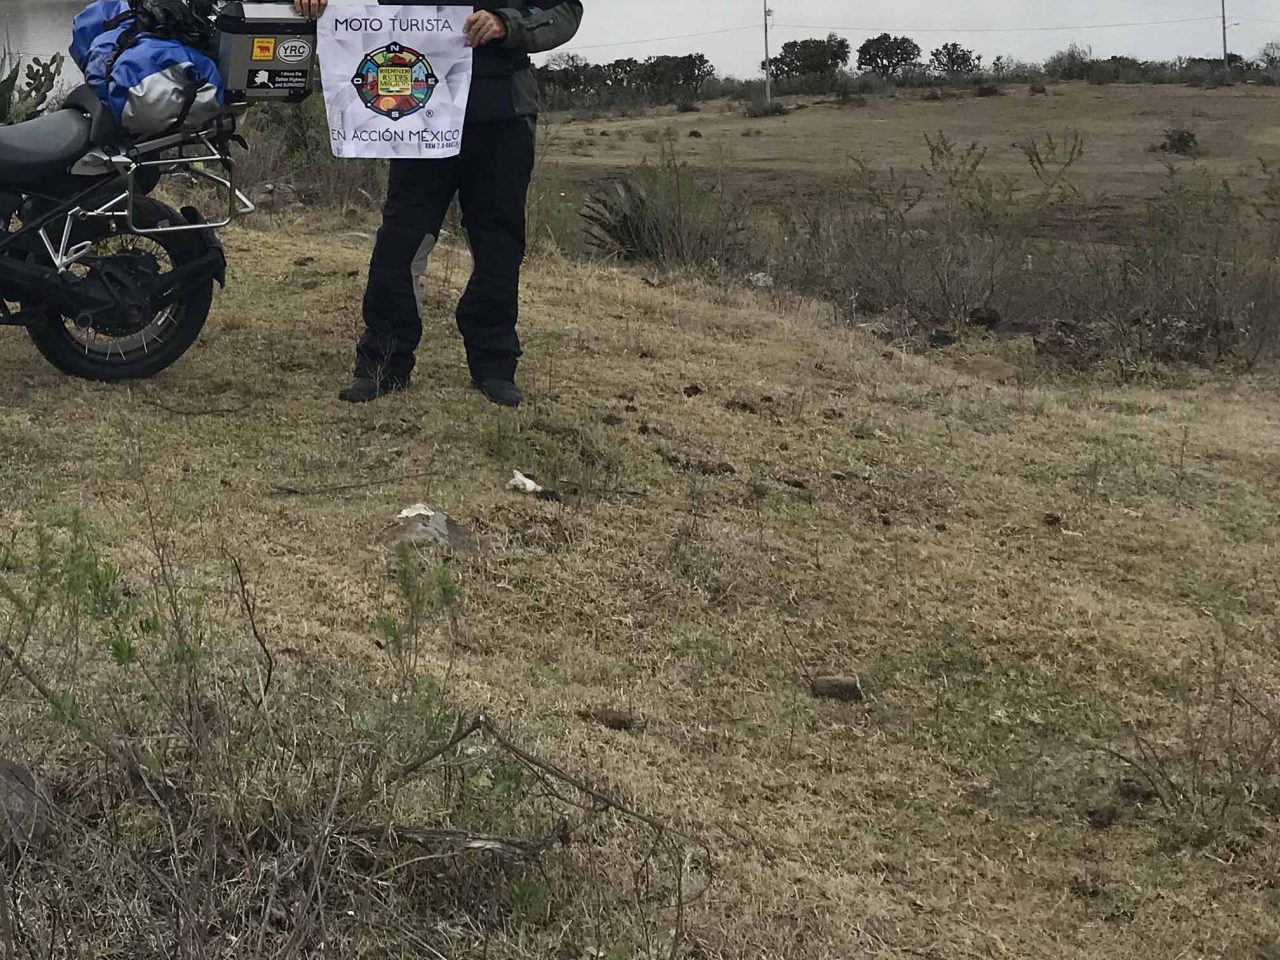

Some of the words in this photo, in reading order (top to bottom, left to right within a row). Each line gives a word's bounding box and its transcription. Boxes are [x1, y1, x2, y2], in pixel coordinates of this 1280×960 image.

[334, 17, 383, 32] MOTO
[391, 16, 453, 32] TURISTA
[282, 45, 306, 54] YRC
[331, 128, 347, 141] EN
[351, 127, 404, 142] ACCIÓN
[408, 127, 460, 142] MÉXICO
